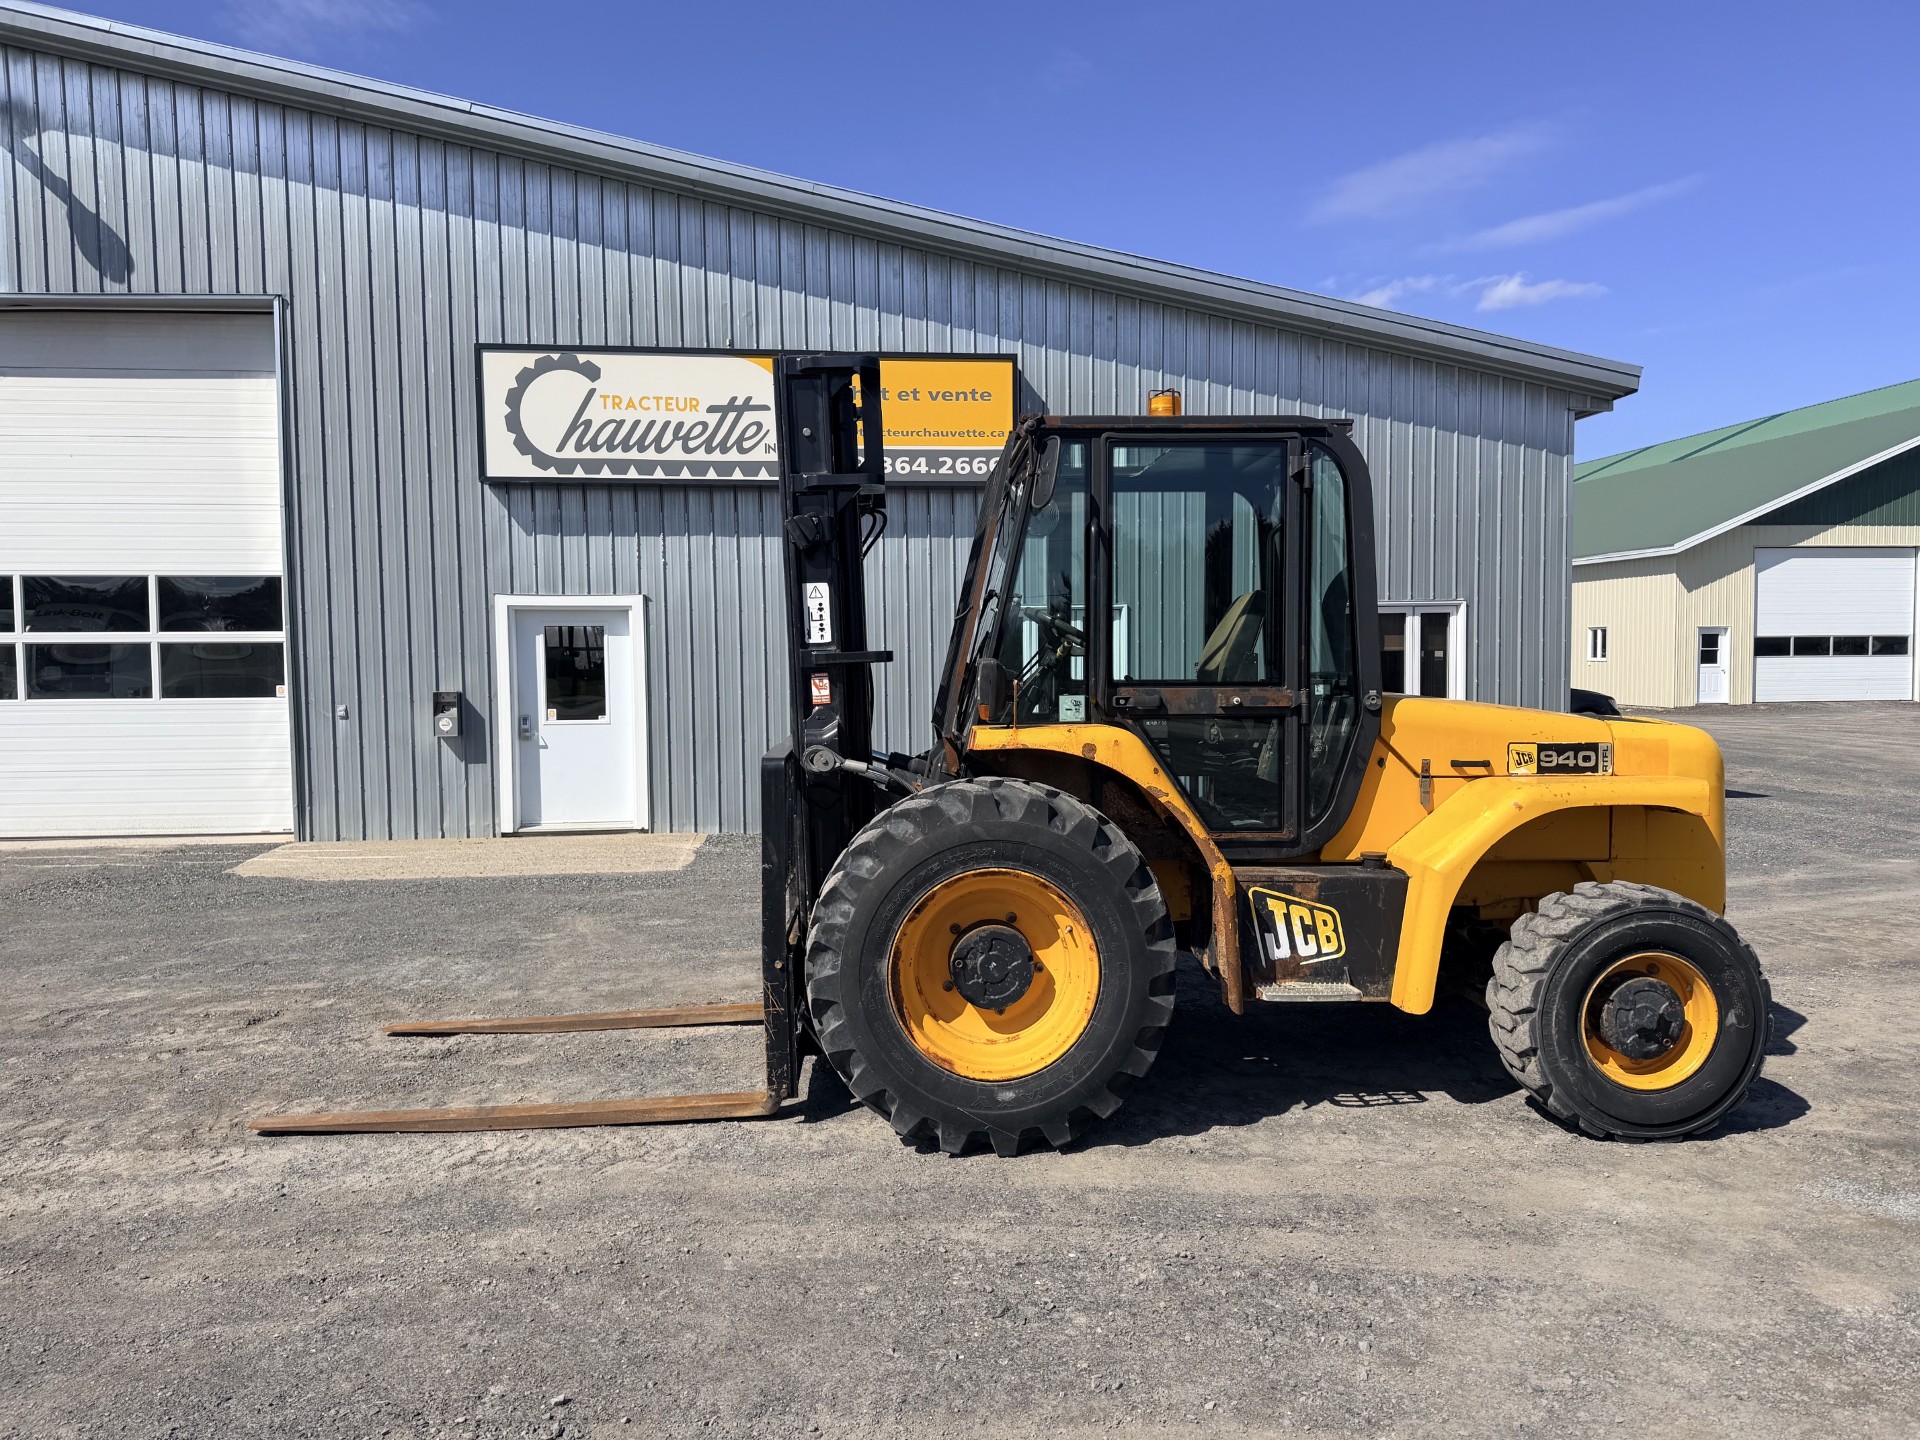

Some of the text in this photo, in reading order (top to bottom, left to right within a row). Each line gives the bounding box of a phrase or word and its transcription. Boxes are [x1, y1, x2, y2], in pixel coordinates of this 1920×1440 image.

[599, 394, 700, 413] TRACTEUR
[897, 388, 921, 402] et
[928, 388, 993, 402] vente
[504, 353, 773, 476] Chauvette
[1514, 745, 1609, 773] JCB 940 RTFL
[1264, 897, 1339, 961] JCB
